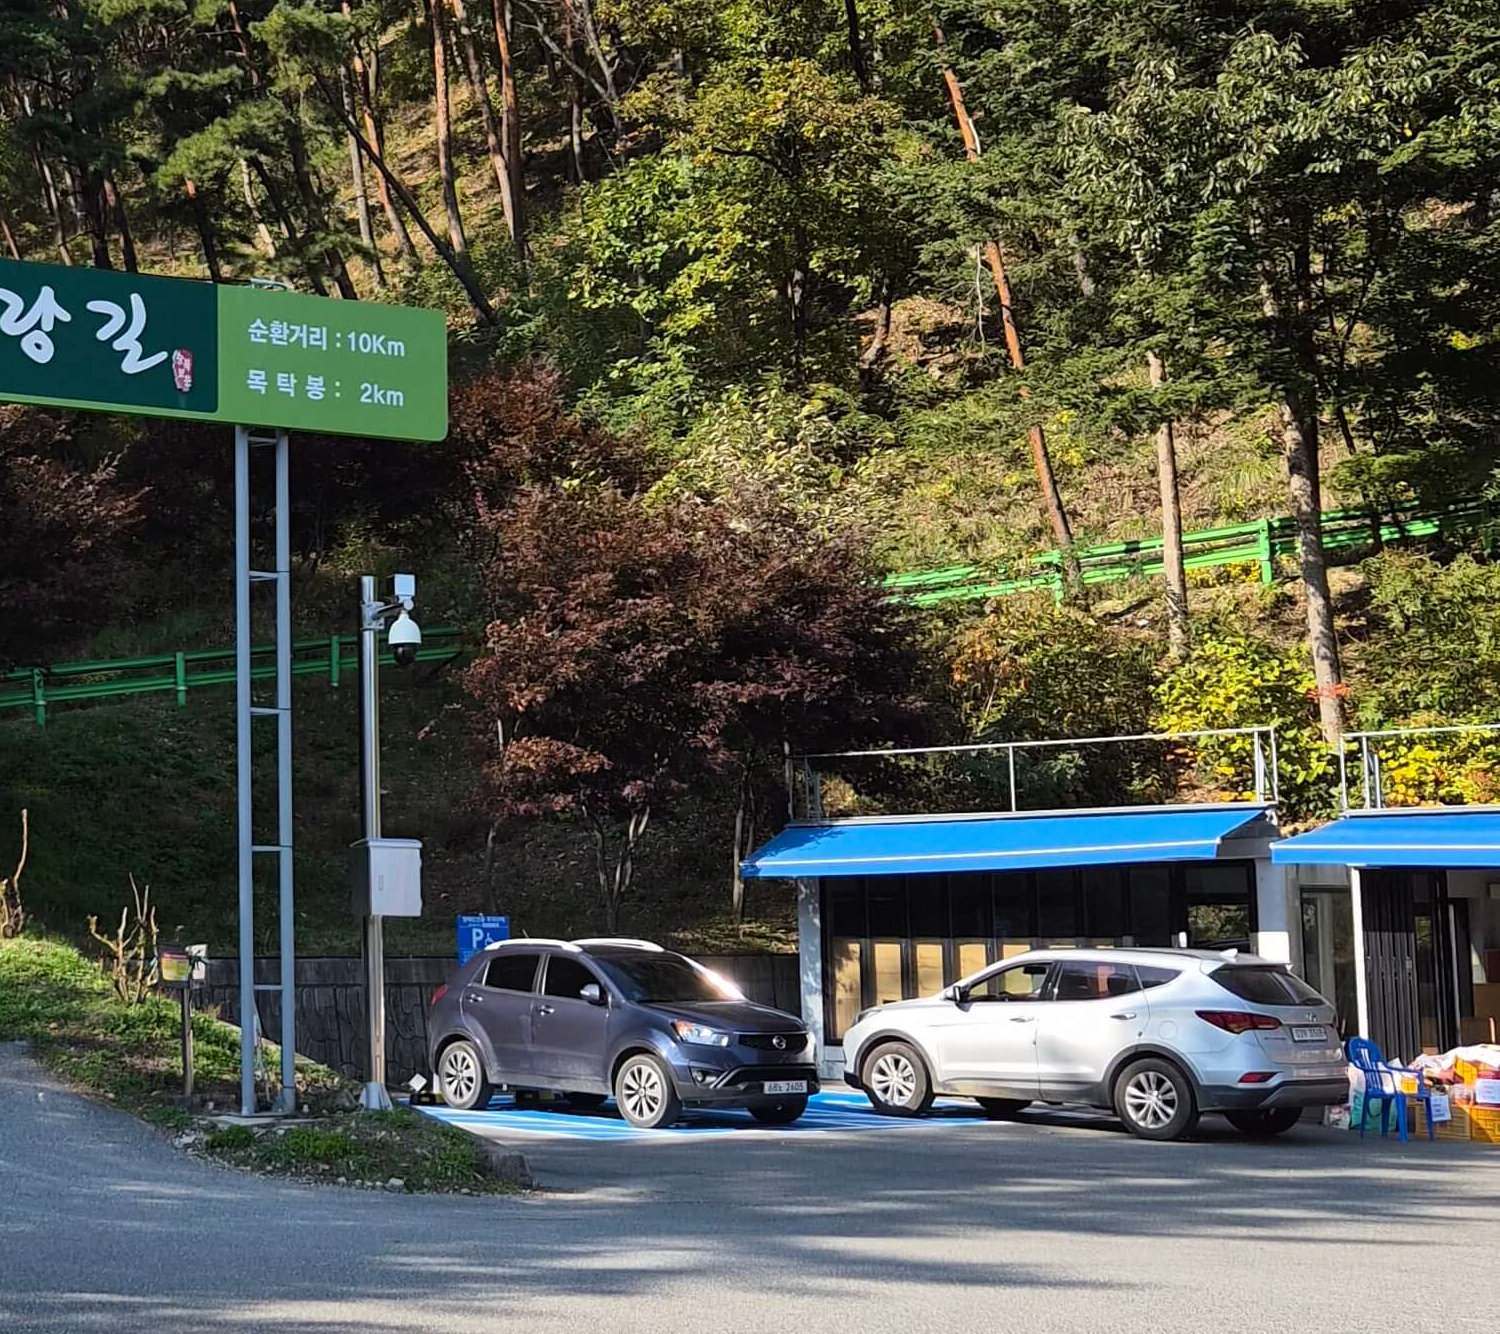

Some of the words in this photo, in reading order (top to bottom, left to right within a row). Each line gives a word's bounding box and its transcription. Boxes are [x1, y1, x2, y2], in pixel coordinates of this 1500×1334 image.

[248, 318, 327, 351] 순환거리
[347, 331, 405, 357] 10Km
[360, 382, 404, 407] 2km
[472, 928, 484, 948] P
